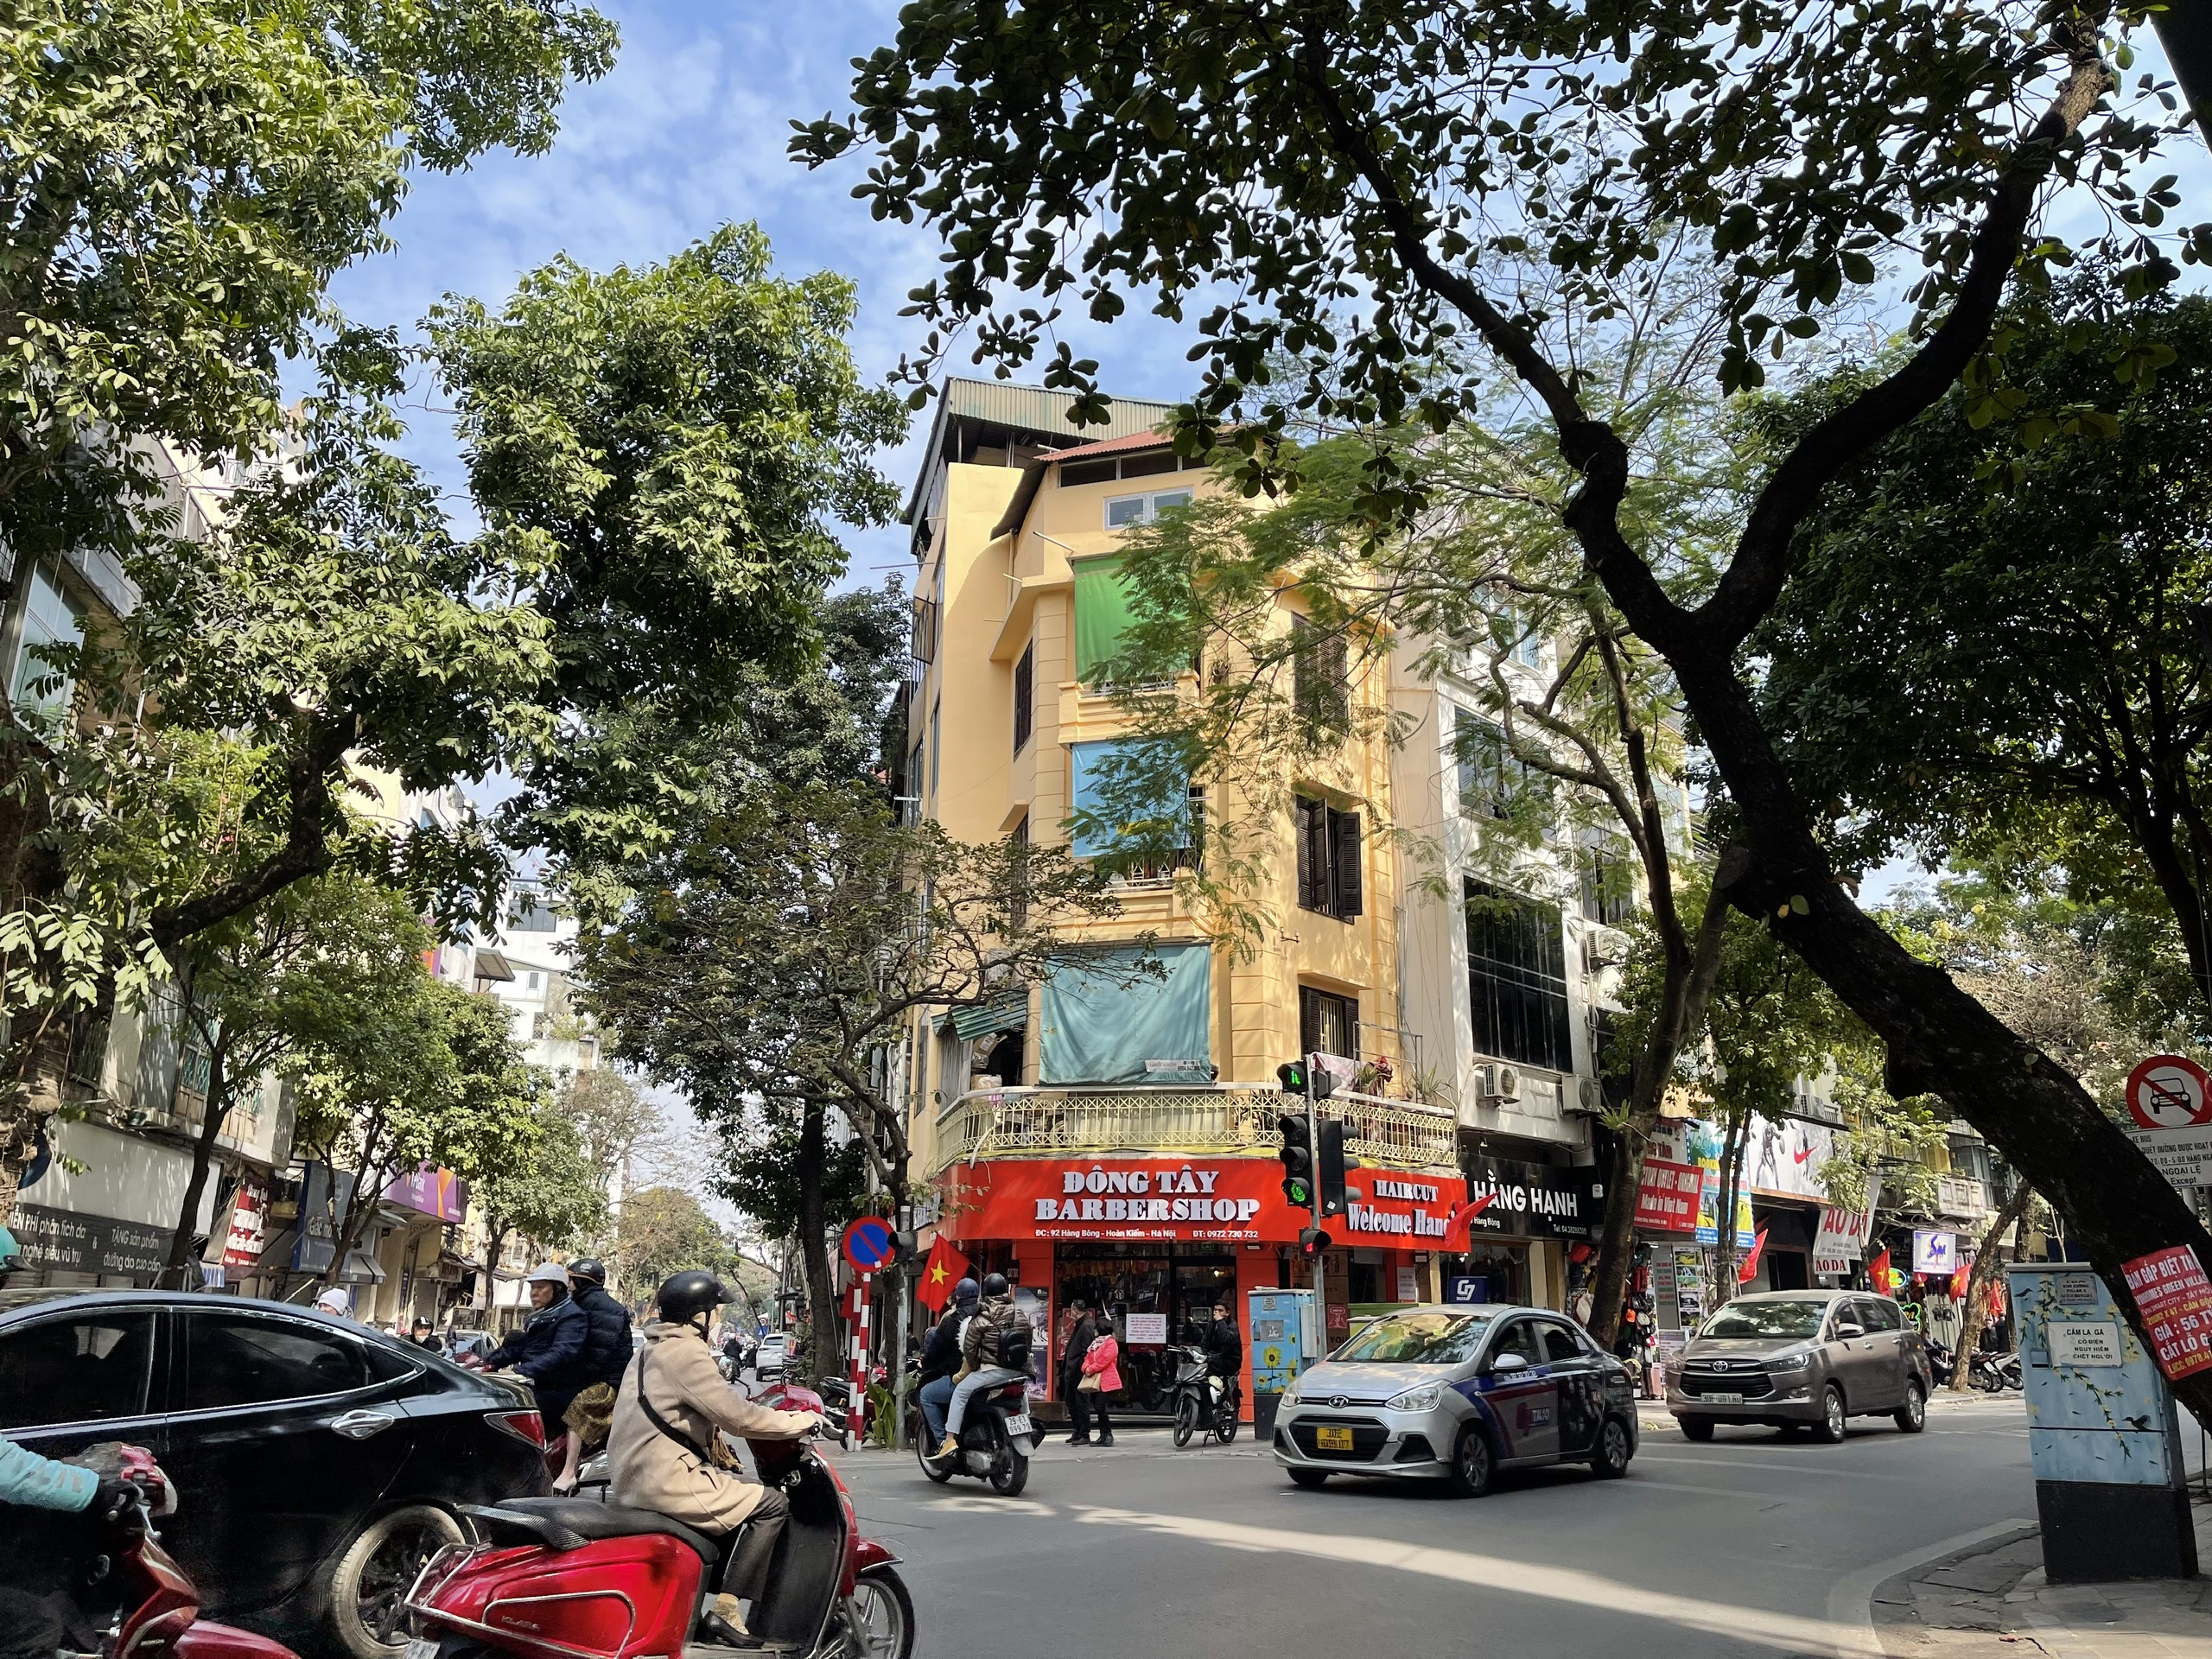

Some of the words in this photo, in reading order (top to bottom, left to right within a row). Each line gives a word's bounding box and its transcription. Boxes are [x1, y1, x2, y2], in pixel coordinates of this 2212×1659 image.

[1063, 1164, 1150, 1194] ĐÔNG
[1155, 1164, 1219, 1194] TÂY
[2161, 1166, 2189, 1176] NGOẠI
[2190, 1165, 2202, 1175] LỆ
[2170, 1177, 2197, 1185] Except
[1375, 1179, 1439, 1202] HAIRCUT
[1473, 1168, 1527, 1212] HẰNG
[1529, 1187, 1579, 1222] HẠNH
[1035, 1198, 1261, 1222] BARBERSHOP
[1347, 1203, 1412, 1234] Welcome
[24, 1211, 40, 1233] PHÍ
[39, 1217, 60, 1236] phân
[1473, 1216, 1487, 1227] Hàng
[1061, 1229, 1080, 1238] Hàng
[1106, 1229, 1125, 1237] Hoàn
[1151, 1229, 1162, 1237] Hà
[1163, 1229, 1176, 1239] Nội
[1227, 1230, 1243, 1238] 730
[1831, 1259, 1847, 1272] DA
[2140, 1259, 2158, 1284] GẤP
[2158, 1255, 2182, 1278] BIỆT
[2161, 1279, 2186, 1295] GREEN
[2184, 1273, 2209, 1288] VILLAS
[2151, 1300, 2168, 1312] SMART
[2167, 1296, 2181, 1306] CITY
[2185, 1289, 2198, 1300] TÂY
[2183, 1300, 2200, 1312] CĂN
[2154, 1320, 2175, 1342] GIÁ
[2179, 1314, 2200, 1332] 56
[2160, 1339, 2181, 1361] CẮT
